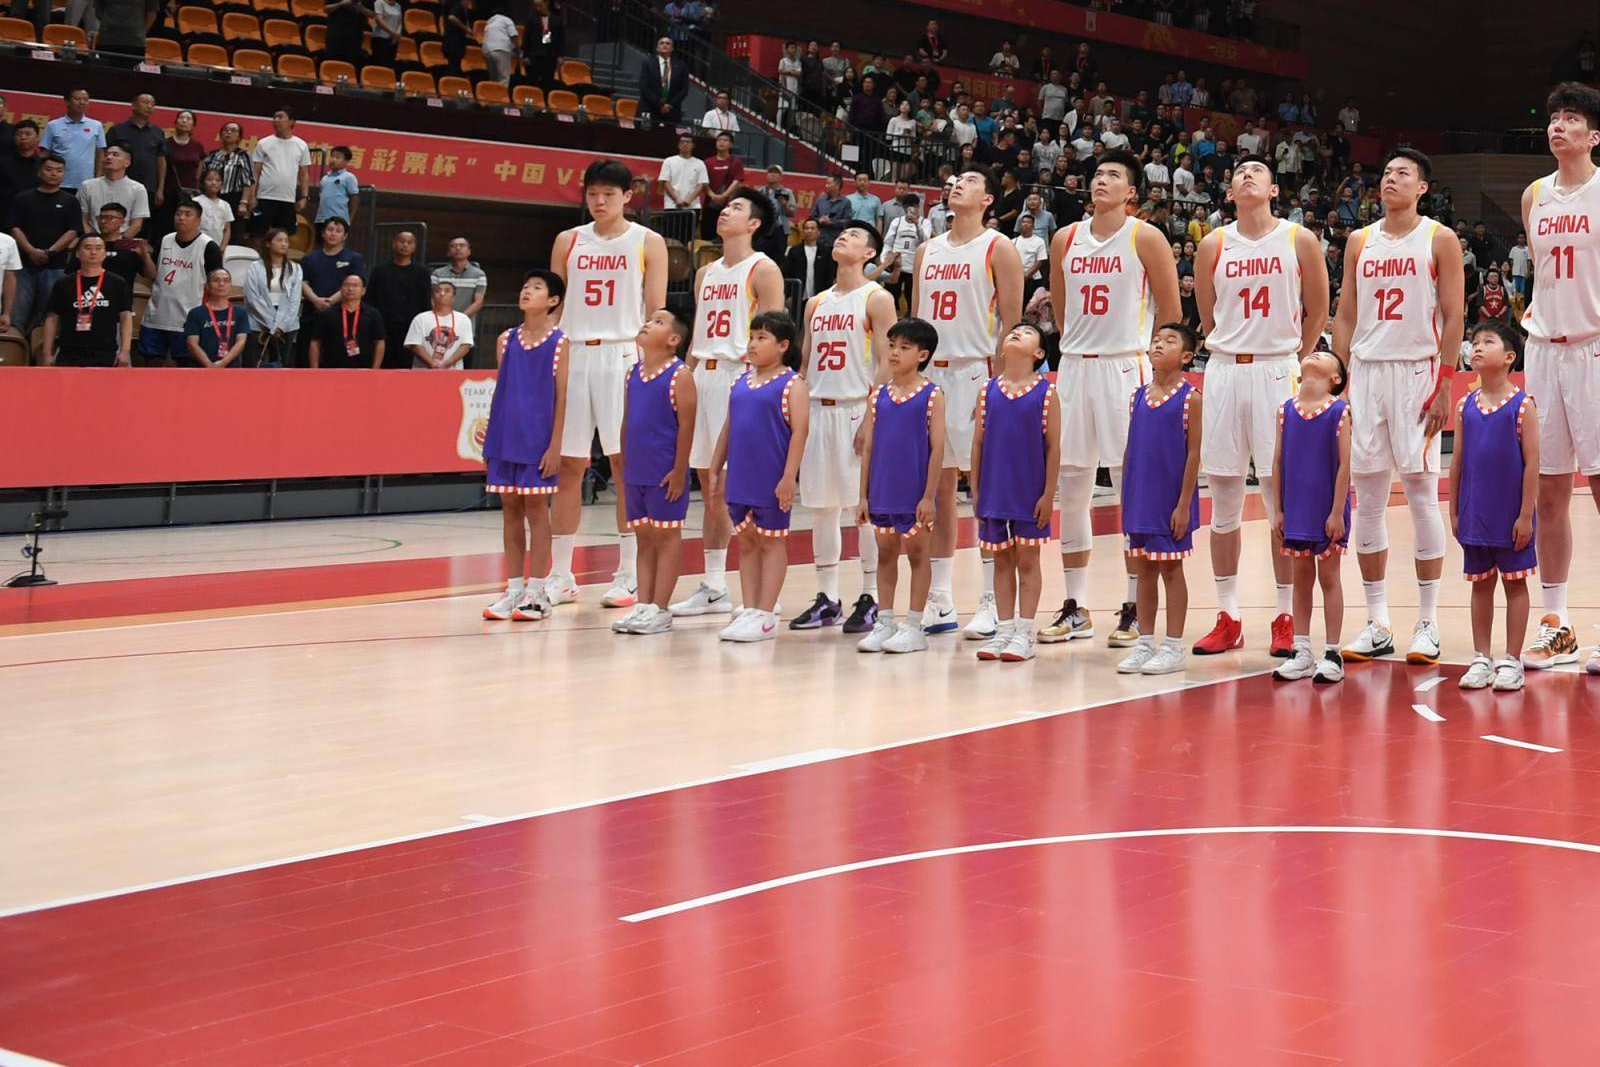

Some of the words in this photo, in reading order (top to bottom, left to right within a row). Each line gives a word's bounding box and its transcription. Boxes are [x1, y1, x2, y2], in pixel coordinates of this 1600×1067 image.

[494, 160, 546, 185] 中国
[1539, 214, 1591, 236] CHINA
[161, 257, 194, 270] CHINA
[578, 255, 627, 272] CHINA
[925, 263, 971, 280] CHINA
[1070, 256, 1122, 275] CHINA
[1226, 256, 1282, 278] CHINA
[1362, 257, 1417, 278] CHINA
[1551, 245, 1575, 279] 11
[164, 269, 177, 286] 4
[584, 279, 616, 307] 51
[703, 284, 738, 302] CHINA
[1080, 284, 1109, 315] 16
[1238, 286, 1270, 319] 14
[1375, 288, 1405, 320] 12
[930, 290, 958, 321] 18
[707, 310, 731, 338] 26
[812, 312, 855, 333] CHINA
[817, 341, 848, 372] 25
[464, 388, 485, 396] TEAM
